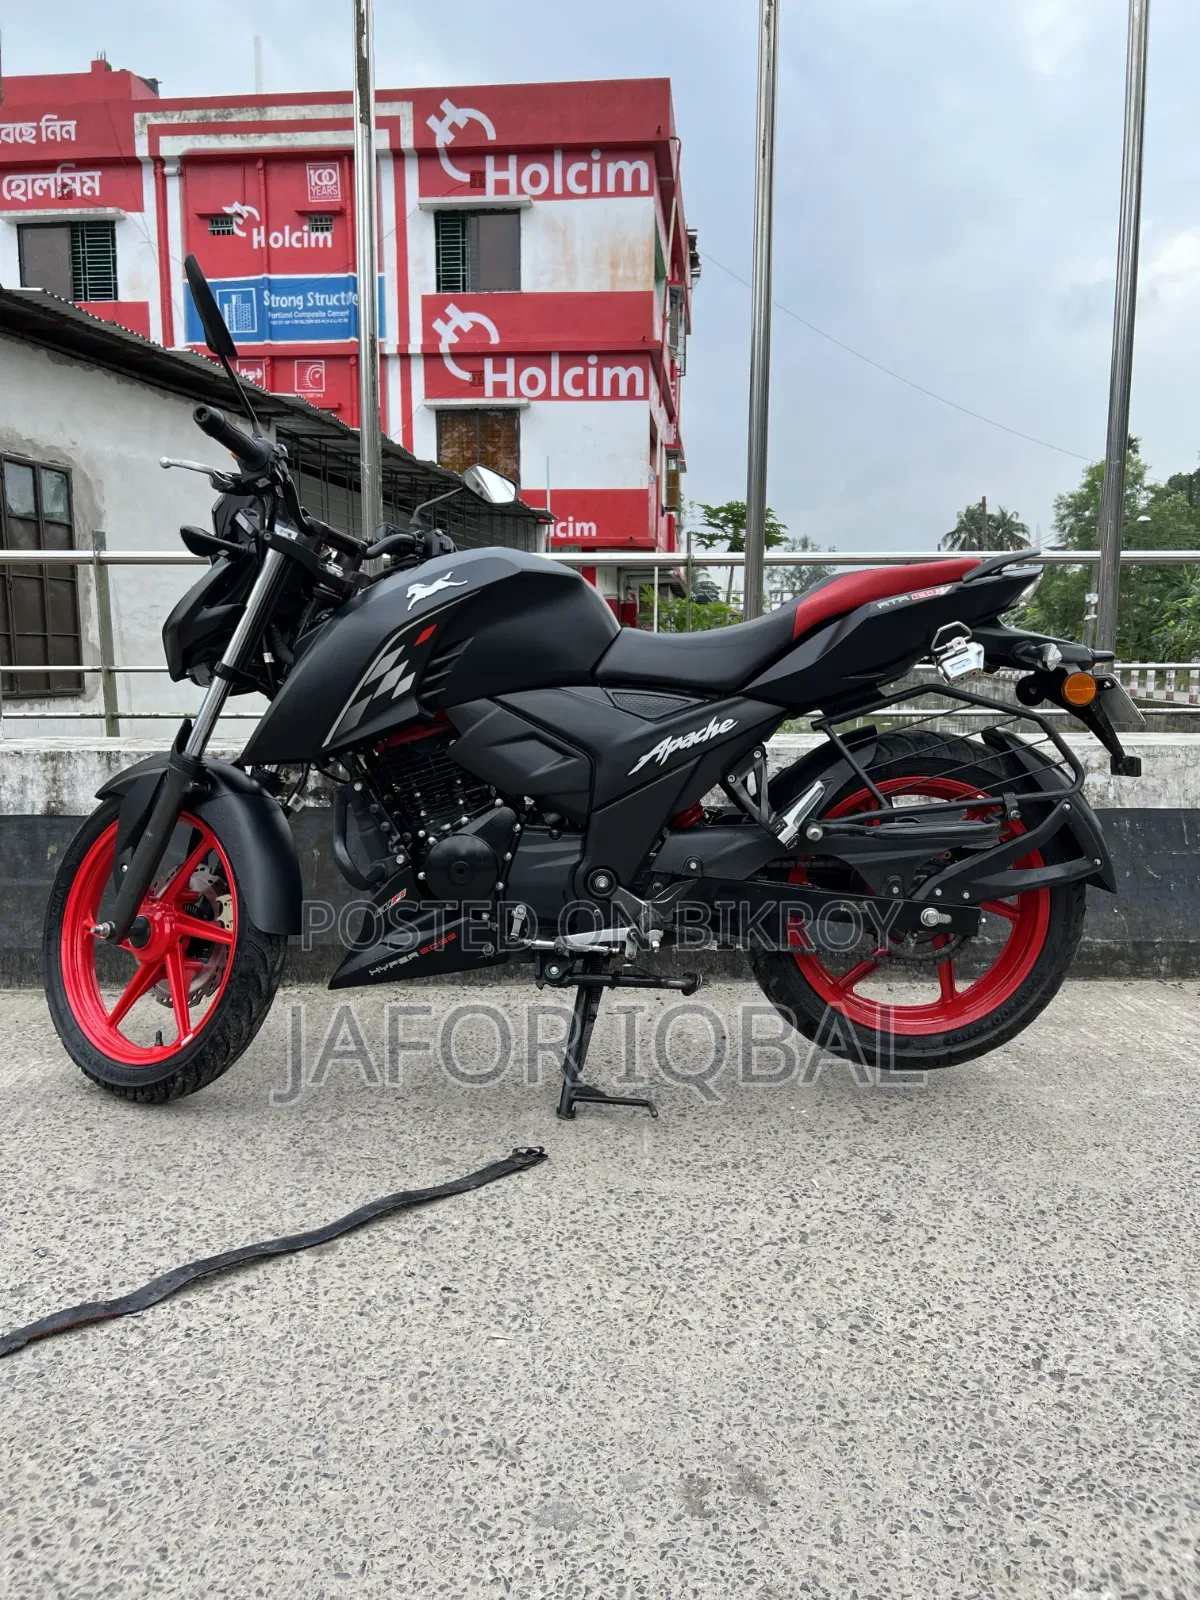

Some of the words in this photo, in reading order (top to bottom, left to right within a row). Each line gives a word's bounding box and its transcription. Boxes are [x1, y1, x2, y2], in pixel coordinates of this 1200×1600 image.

[0, 122, 37, 144] বছে
[39, 114, 77, 142] নিন
[2, 163, 102, 202] হোলসিম
[310, 168, 337, 186] 100
[485, 149, 649, 196] Holcim
[310, 185, 339, 196] YEARS
[252, 225, 332, 249] Holcim
[263, 290, 304, 310] Strong
[268, 311, 293, 319] Portland
[294, 310, 326, 319] Composite
[484, 352, 644, 398] Holcim
[545, 516, 597, 537] lcim
[627, 715, 739, 776] Apache
